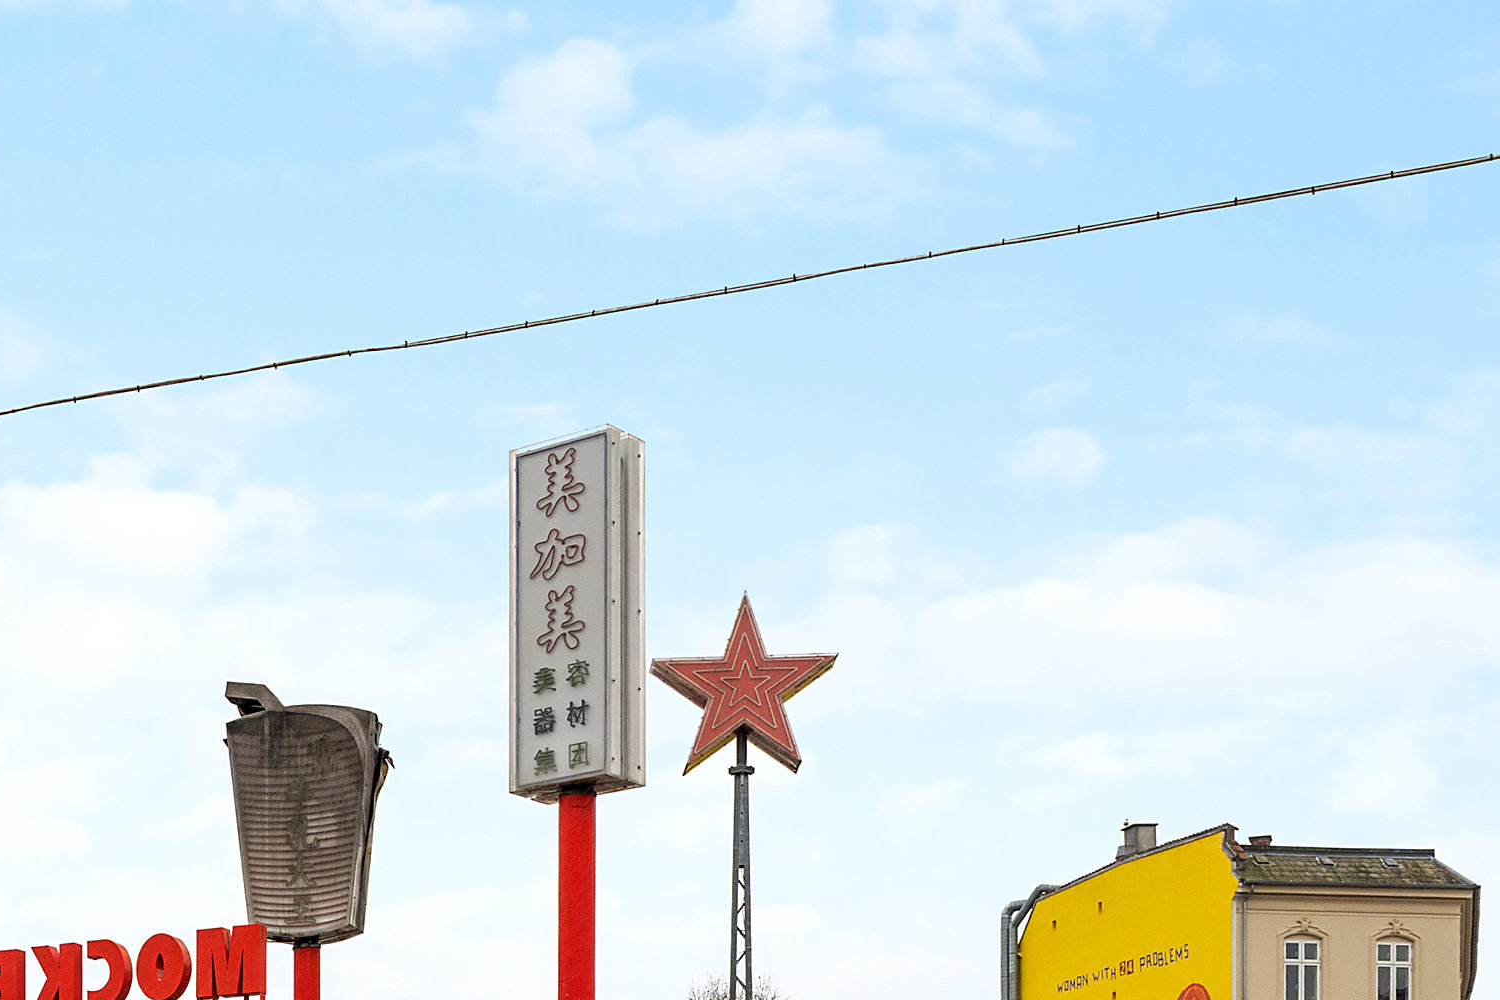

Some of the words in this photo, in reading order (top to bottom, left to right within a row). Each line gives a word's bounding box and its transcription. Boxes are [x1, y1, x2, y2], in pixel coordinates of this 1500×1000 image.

[1057, 974, 1088, 992] WOMAN
[1092, 967, 1116, 981] WITH
[1140, 943, 1189, 972] PROBLEMS
